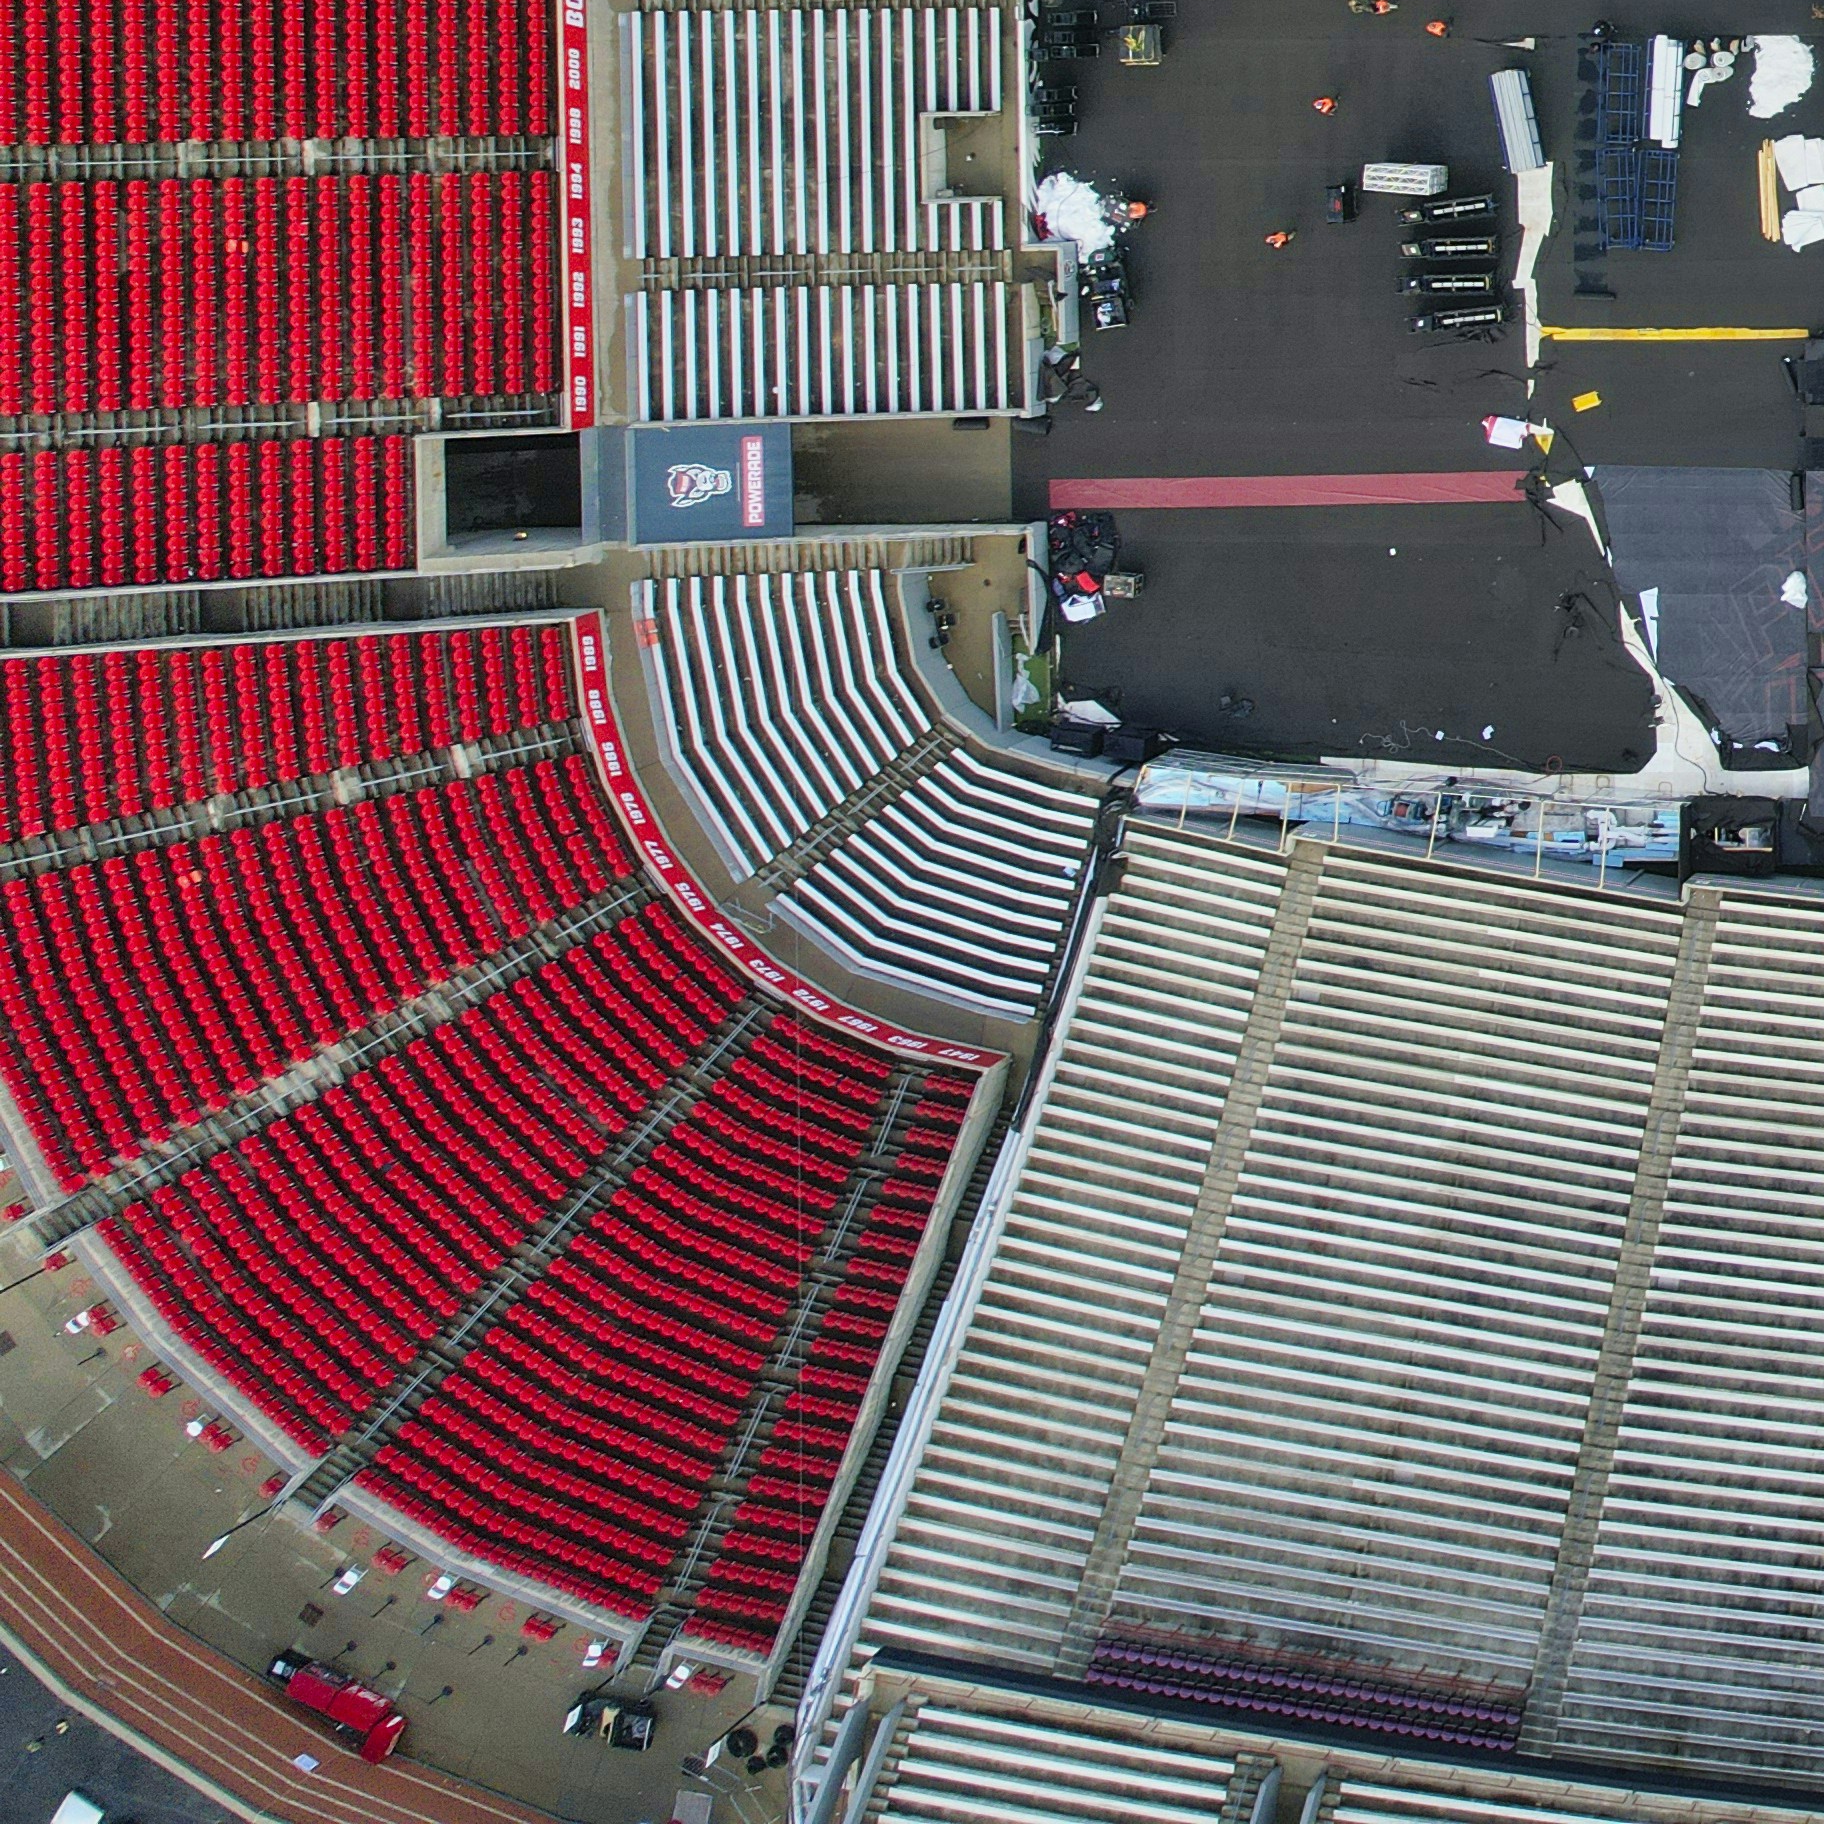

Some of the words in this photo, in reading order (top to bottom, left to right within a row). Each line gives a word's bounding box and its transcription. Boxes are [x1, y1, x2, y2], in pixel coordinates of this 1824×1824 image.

[567, 47, 581, 90] 2000
[570, 162, 583, 200] 1994
[571, 217, 584, 254] 1993
[572, 271, 585, 308] 1992
[573, 325, 586, 358] 1991
[574, 375, 587, 412] 1990
[746, 441, 762, 524] POWERADE
[620, 792, 646, 825] 1978
[643, 840, 674, 870] 1977
[674, 882, 706, 912] 1975
[709, 922, 745, 949] 1974
[749, 959, 786, 983] 1973
[942, 1047, 980, 1062] 1947
